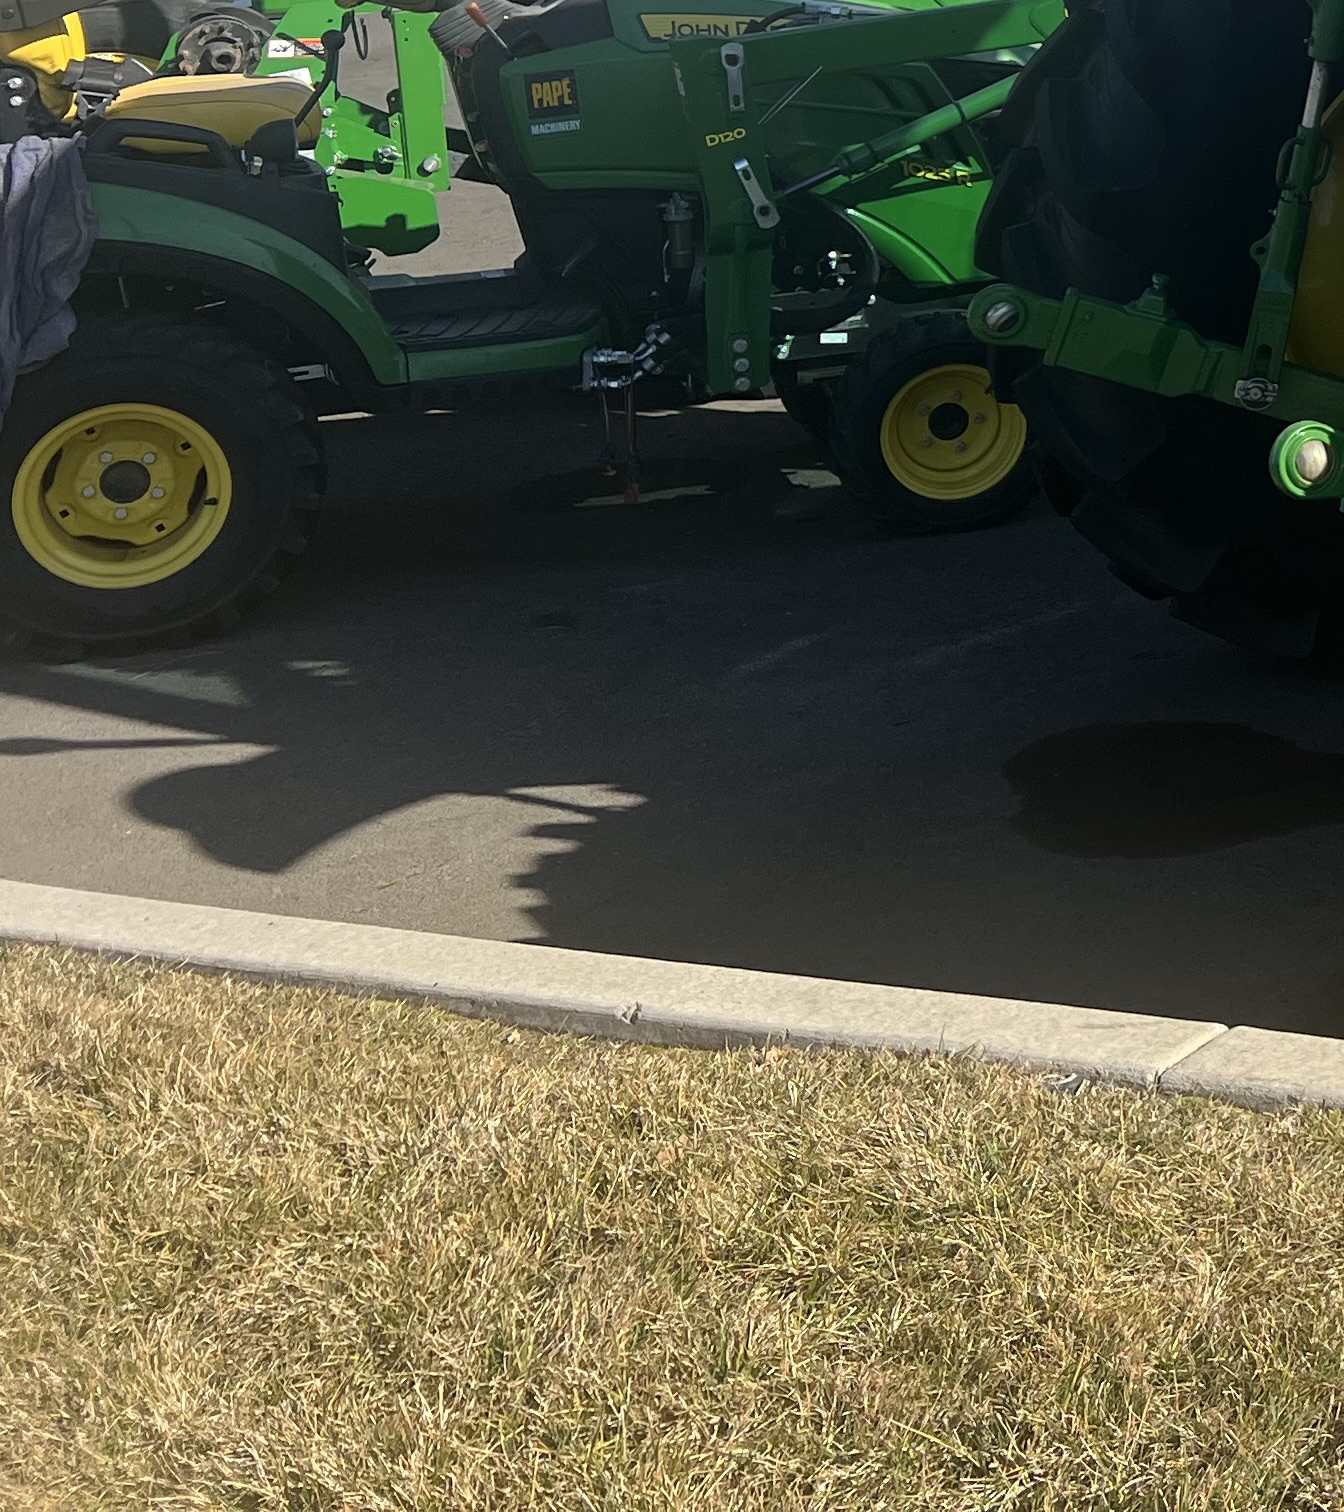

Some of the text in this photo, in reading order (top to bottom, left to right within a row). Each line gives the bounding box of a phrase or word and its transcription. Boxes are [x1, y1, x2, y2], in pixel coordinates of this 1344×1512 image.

[663, 20, 730, 38] JOHN
[530, 119, 581, 135] MACHINERY
[705, 128, 747, 147] D120
